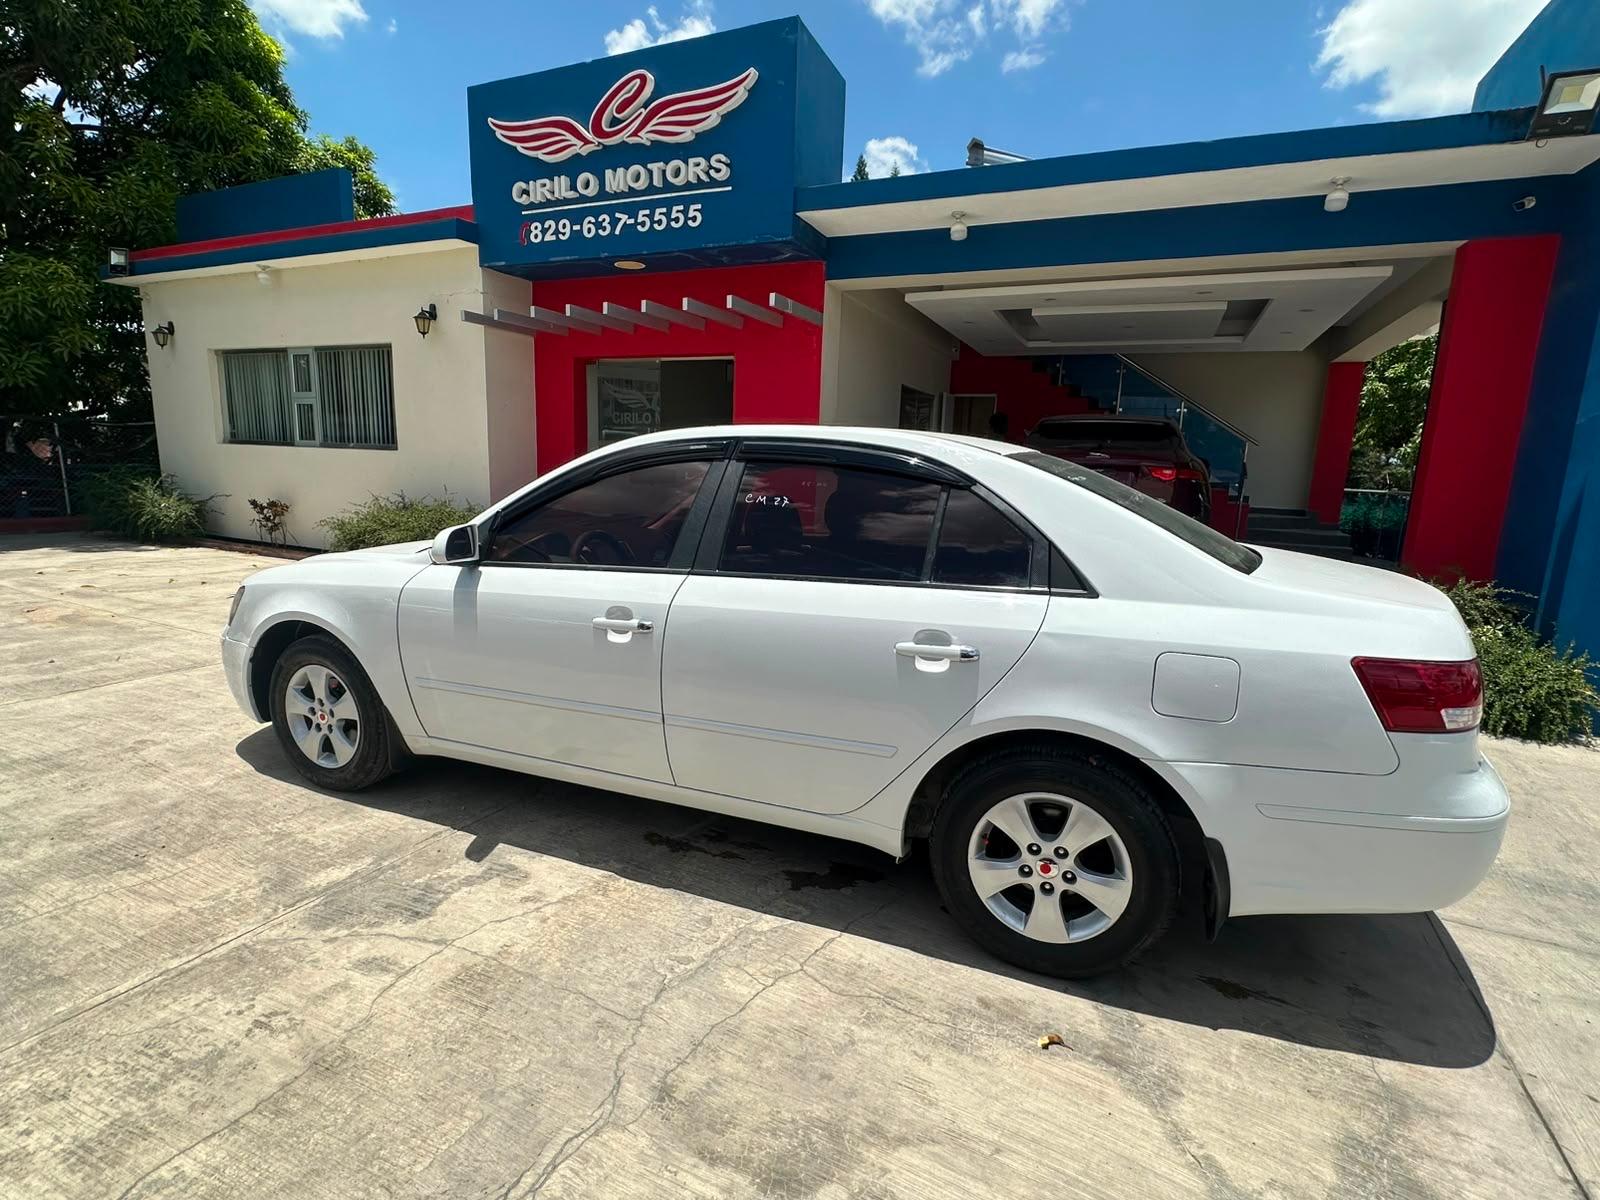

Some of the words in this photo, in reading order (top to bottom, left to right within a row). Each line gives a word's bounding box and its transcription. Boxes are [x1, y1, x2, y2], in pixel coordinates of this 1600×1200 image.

[512, 172, 599, 205] CIRILO
[605, 154, 730, 193] MOTORS
[530, 204, 702, 243] 829-637-5555
[612, 411, 652, 425] CIRILO
